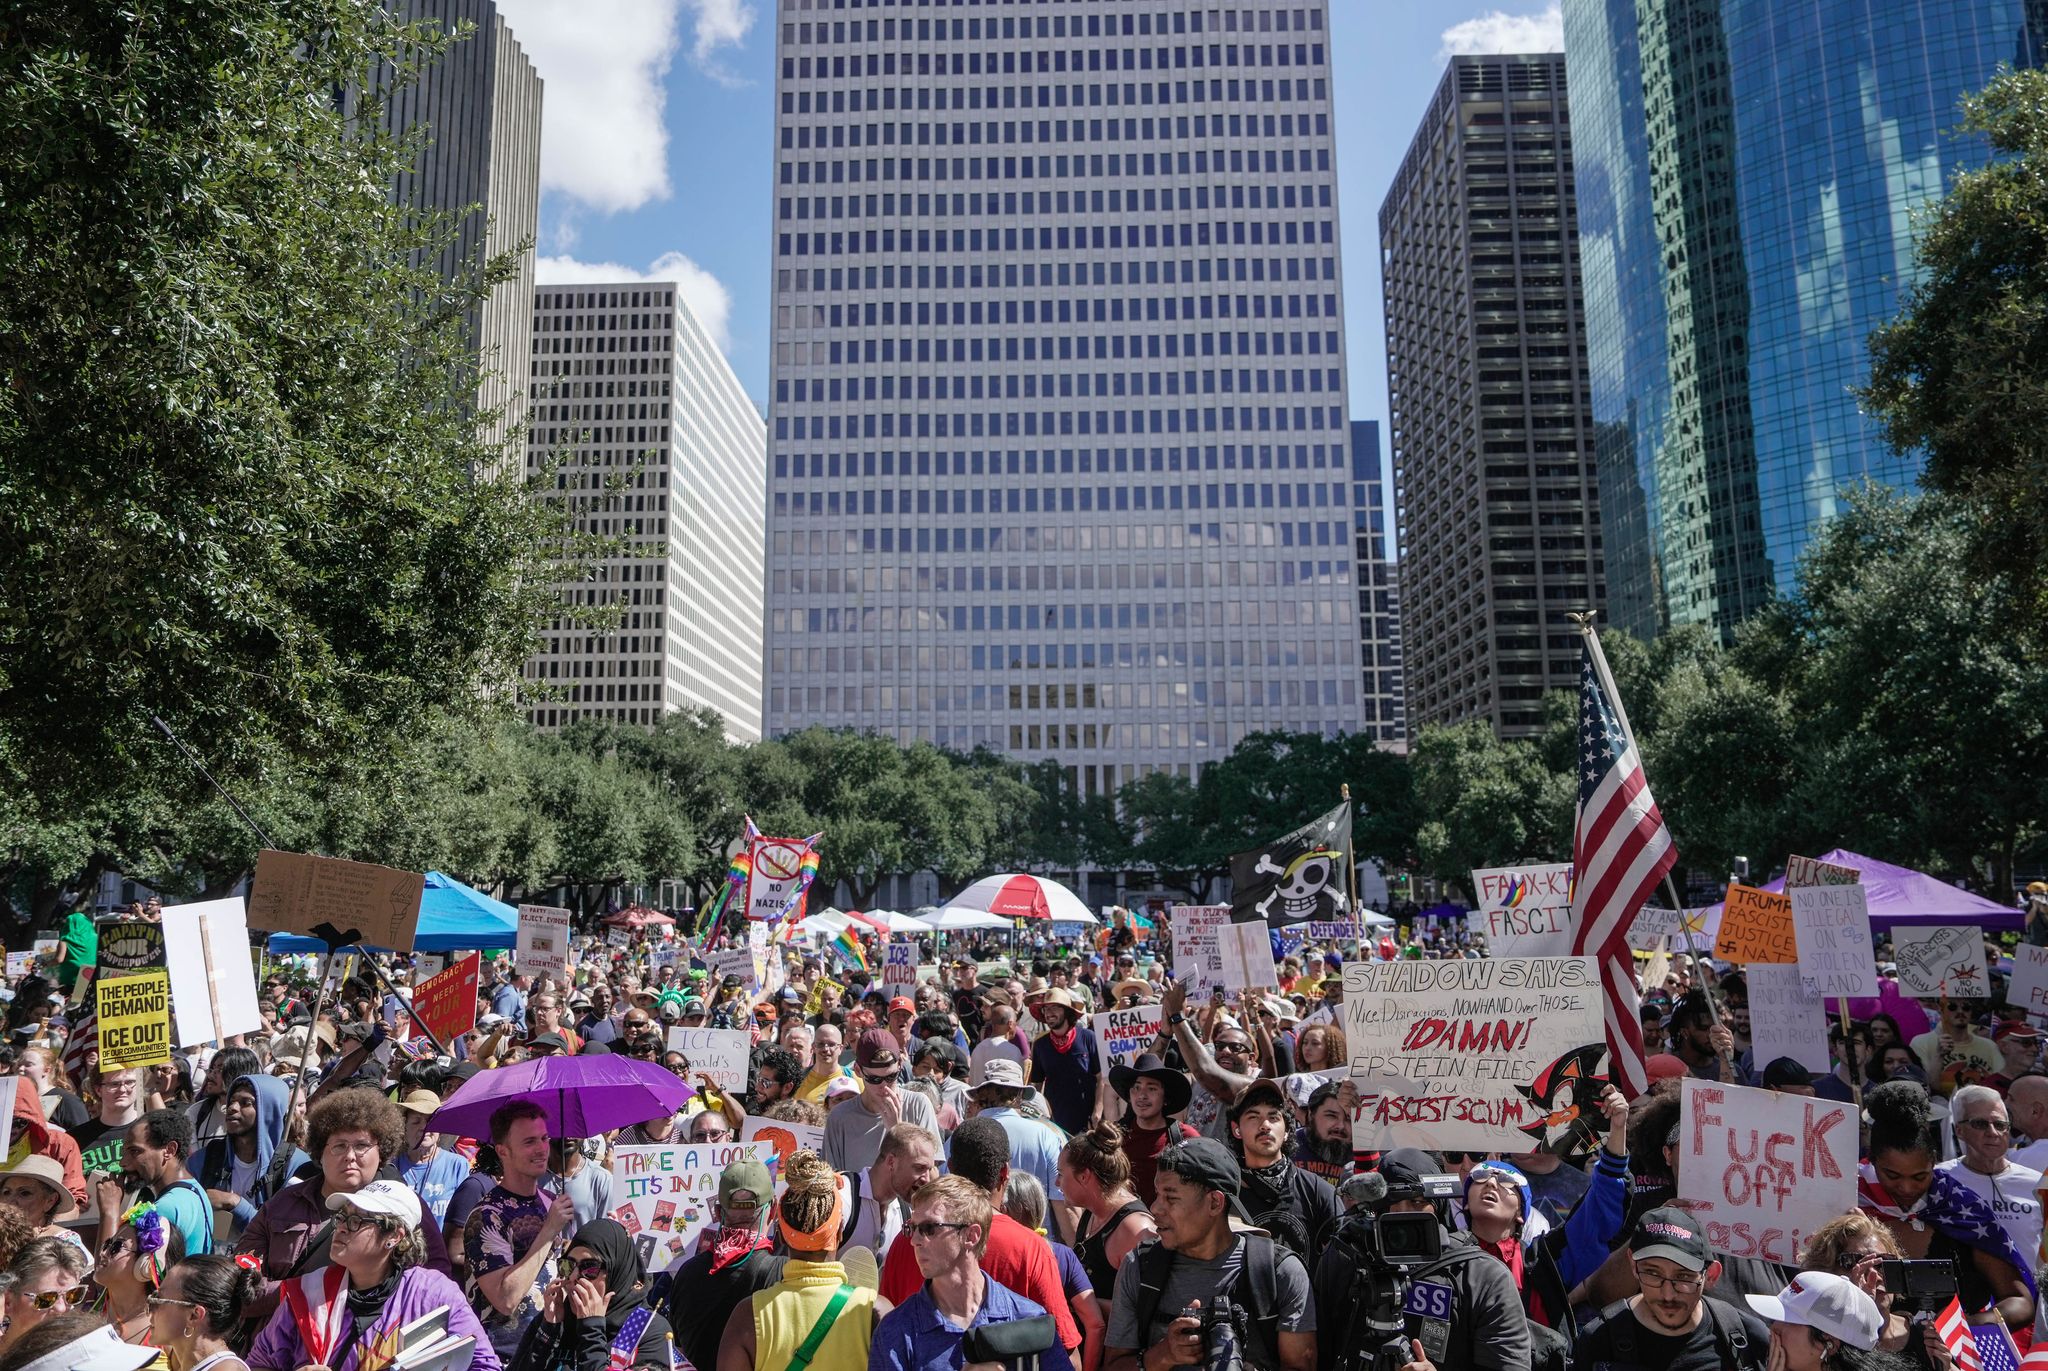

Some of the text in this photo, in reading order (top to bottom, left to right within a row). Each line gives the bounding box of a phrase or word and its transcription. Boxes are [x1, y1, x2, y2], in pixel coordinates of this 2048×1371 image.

[1788, 856, 1826, 885] FUCK
[1826, 863, 1860, 880] TRUMP
[769, 883, 782, 892] NO
[755, 899, 785, 909] NAZIS
[1797, 890, 1862, 908] NO ONE IS
[521, 914, 543, 922] REJECT
[1659, 912, 1679, 924] AND
[1728, 906, 1793, 931] FASCIST
[1801, 908, 1859, 928] ILLEGAL
[101, 924, 163, 947] EMPATHY
[1629, 923, 1667, 934] JUSTICE
[1723, 922, 1794, 950] JUSTICE
[116, 939, 148, 956] OUR
[1814, 929, 1837, 949] ON
[101, 947, 162, 967] SUPERPOWER
[1809, 952, 1866, 971] STOLEN
[1906, 943, 1919, 967] KILLS
[415, 962, 465, 996] DEMOCRACY
[1343, 959, 1600, 993] SHADOW SAYS...
[1817, 973, 1863, 993] LAND
[1909, 973, 1931, 991] THIS
[100, 980, 164, 1000] THE PEOPLE
[433, 982, 459, 1003] NEEDS
[894, 985, 900, 997] A
[1755, 988, 1777, 1005] AND
[1954, 986, 1983, 997] KINGS
[102, 995, 164, 1018] DEMAND
[1348, 998, 1379, 1023] Nice
[1538, 994, 1584, 1011] THOSE
[1109, 1011, 1147, 1027] REAL
[1751, 1010, 1776, 1024] THIS
[103, 1022, 165, 1049] ICE OUT
[677, 1030, 720, 1050] ICE
[1789, 1028, 1826, 1045] RIGHT
[102, 1043, 166, 1058] OF OUR COMMUNITIES!
[1109, 1037, 1152, 1055] BOW TO
[1107, 1053, 1125, 1068] NO
[1350, 1056, 1537, 1081] EPSTEIN FILES
[1354, 1095, 1523, 1127] FASCIST SCUM
[617, 1145, 757, 1175] TAKE A LOOK
[625, 1172, 714, 1199] IT'S IN A
[1992, 1200, 2032, 1214] RICO
[1412, 1285, 1447, 1316] SS
